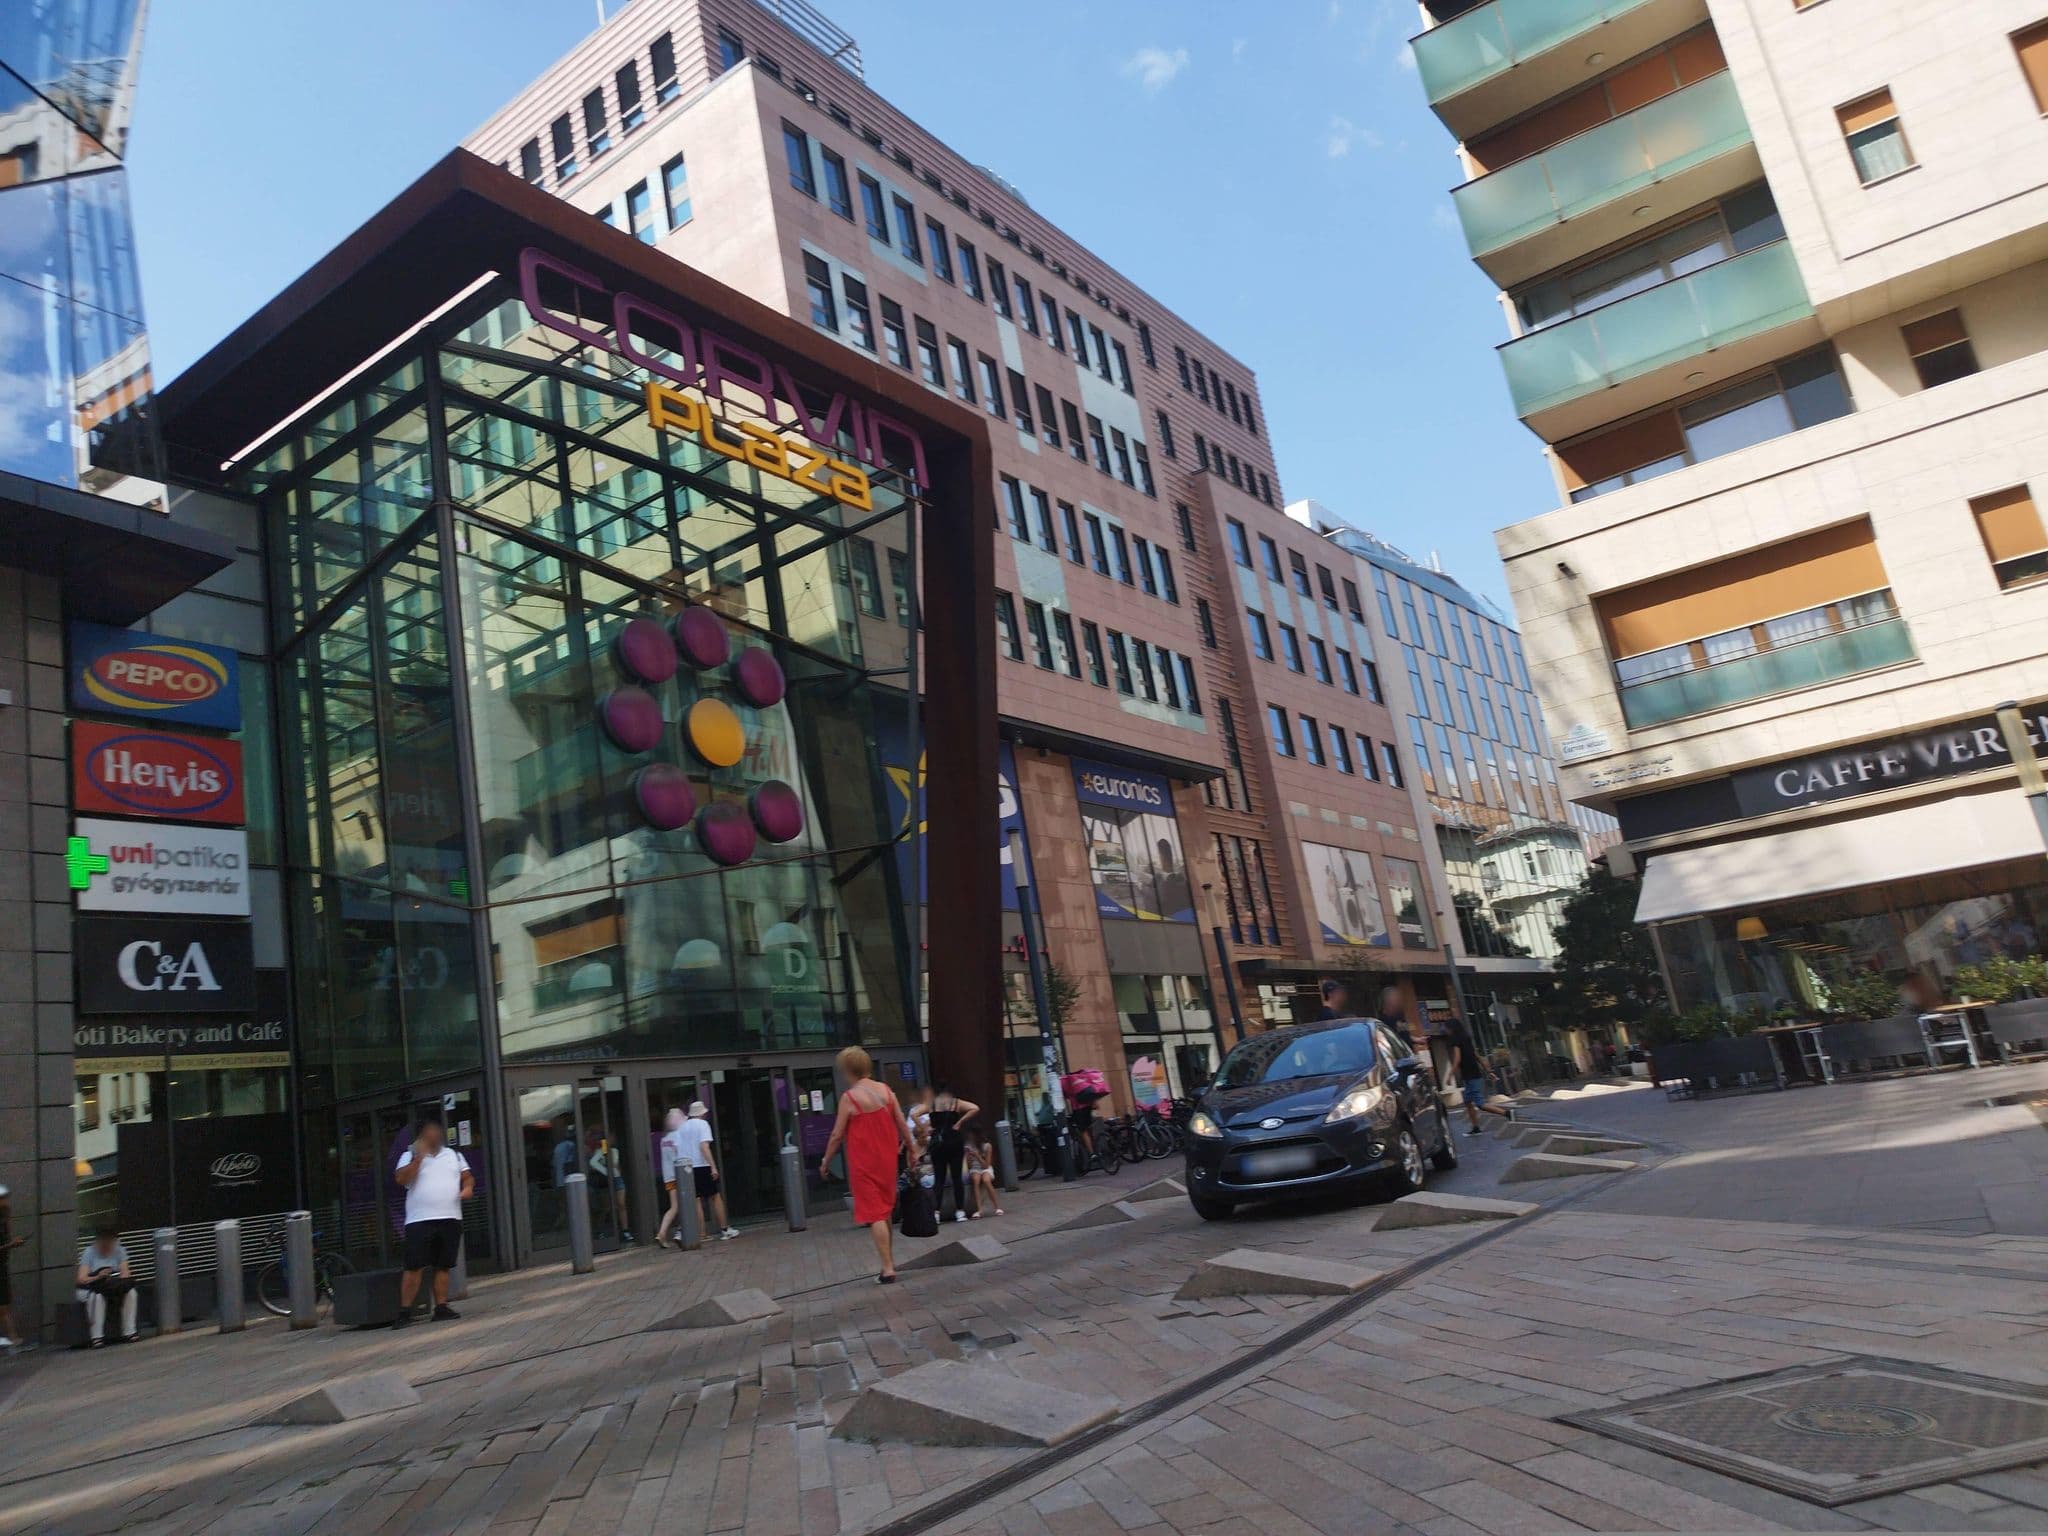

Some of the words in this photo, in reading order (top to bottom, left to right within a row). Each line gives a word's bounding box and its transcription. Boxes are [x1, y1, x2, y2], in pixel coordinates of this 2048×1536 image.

[107, 659, 208, 694] PEPCO
[1911, 714, 2048, 770] VER
[102, 748, 222, 797] Hervis
[1093, 774, 1162, 805] euronics
[111, 842, 240, 869] unipatika
[111, 871, 241, 895] gyógyszertár
[118, 940, 222, 991] C&A
[111, 1024, 189, 1047] Bakery
[195, 1024, 233, 1042] and
[238, 1021, 283, 1041] Café
